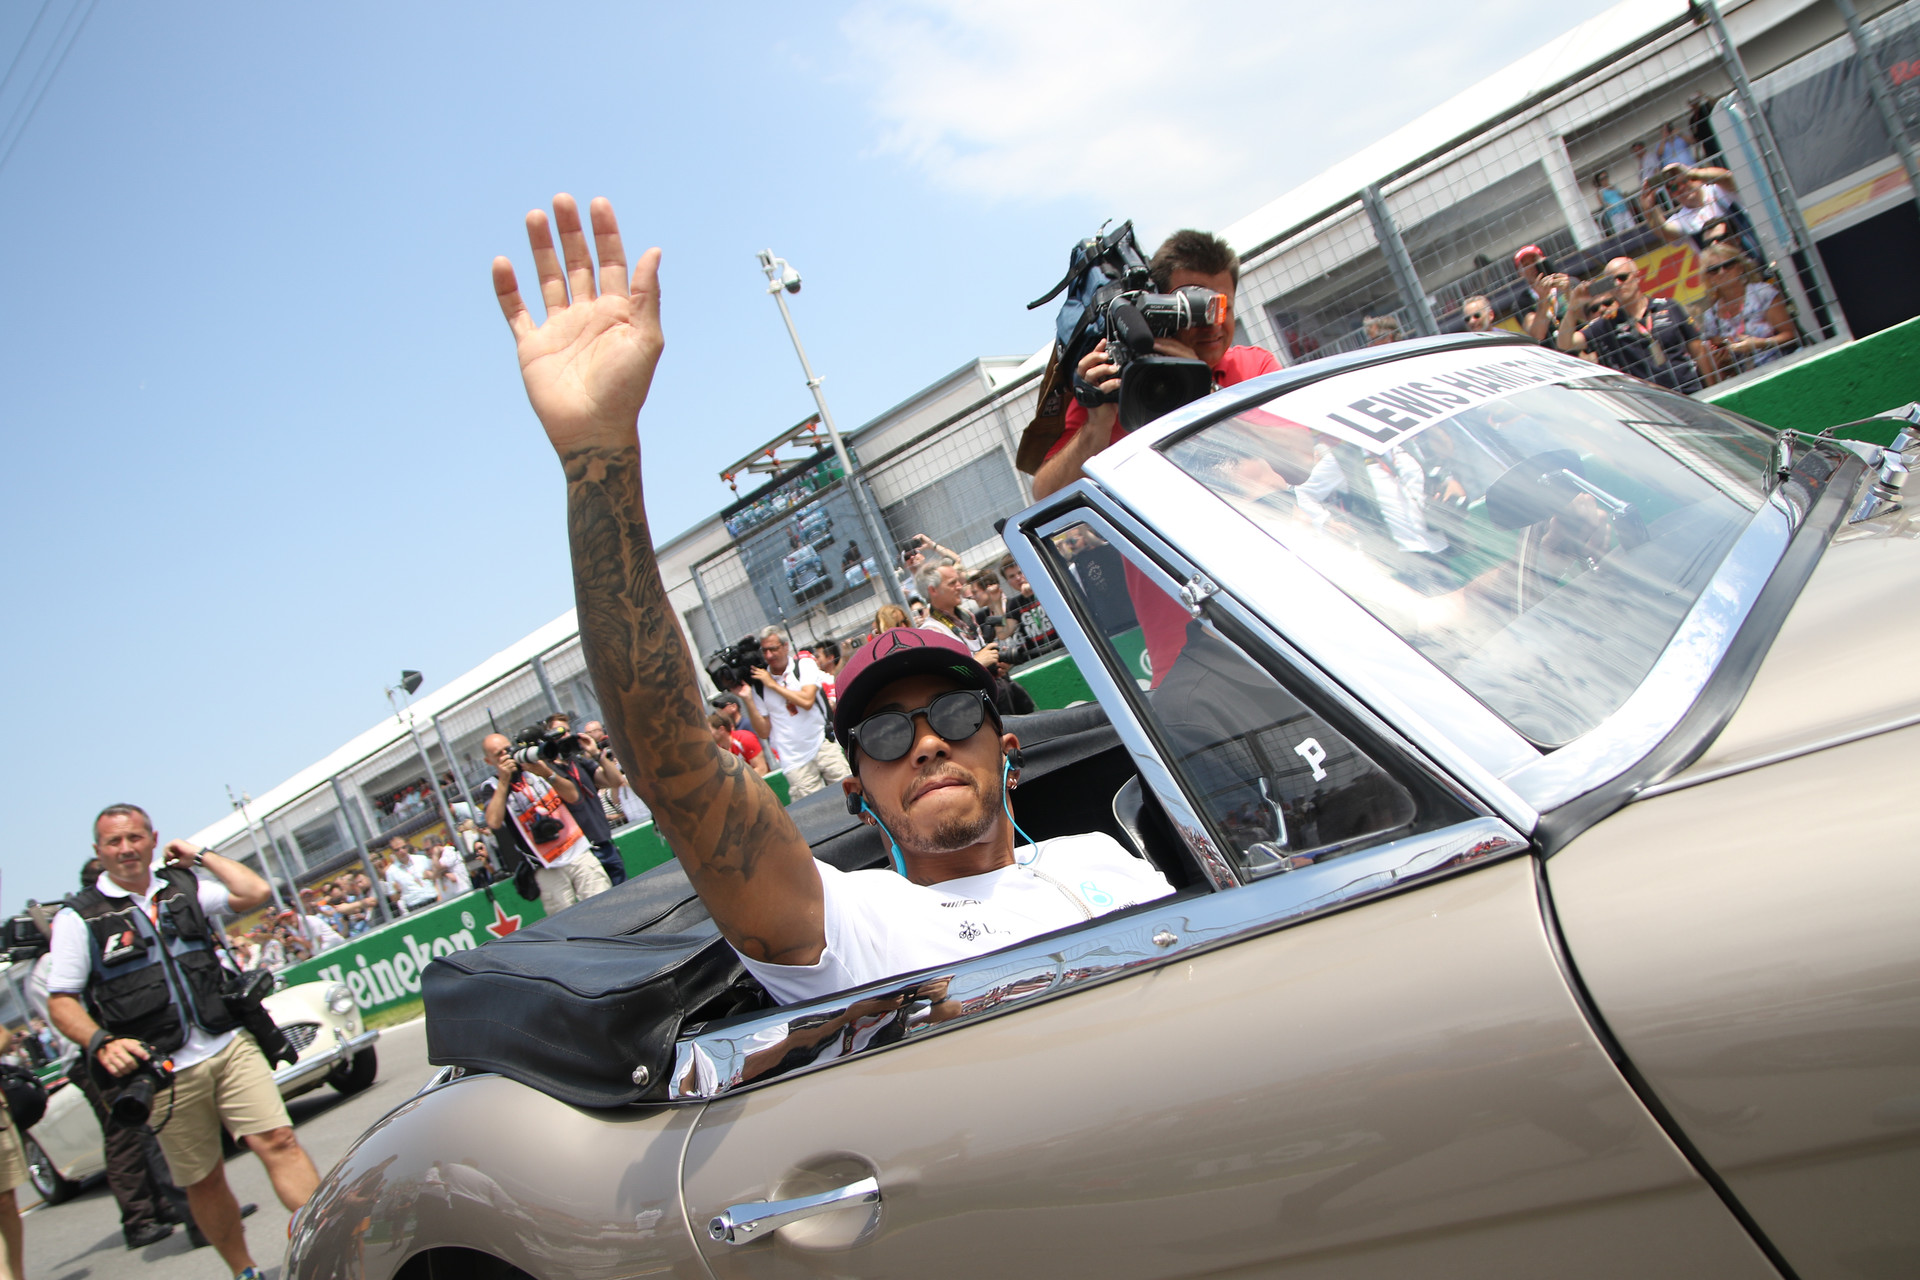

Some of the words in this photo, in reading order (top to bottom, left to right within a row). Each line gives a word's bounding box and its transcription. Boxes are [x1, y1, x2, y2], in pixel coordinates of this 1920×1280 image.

[1326, 382, 1470, 443] LEWIS
[1432, 357, 1577, 397] HAMILTON
[1293, 737, 1327, 782] P
